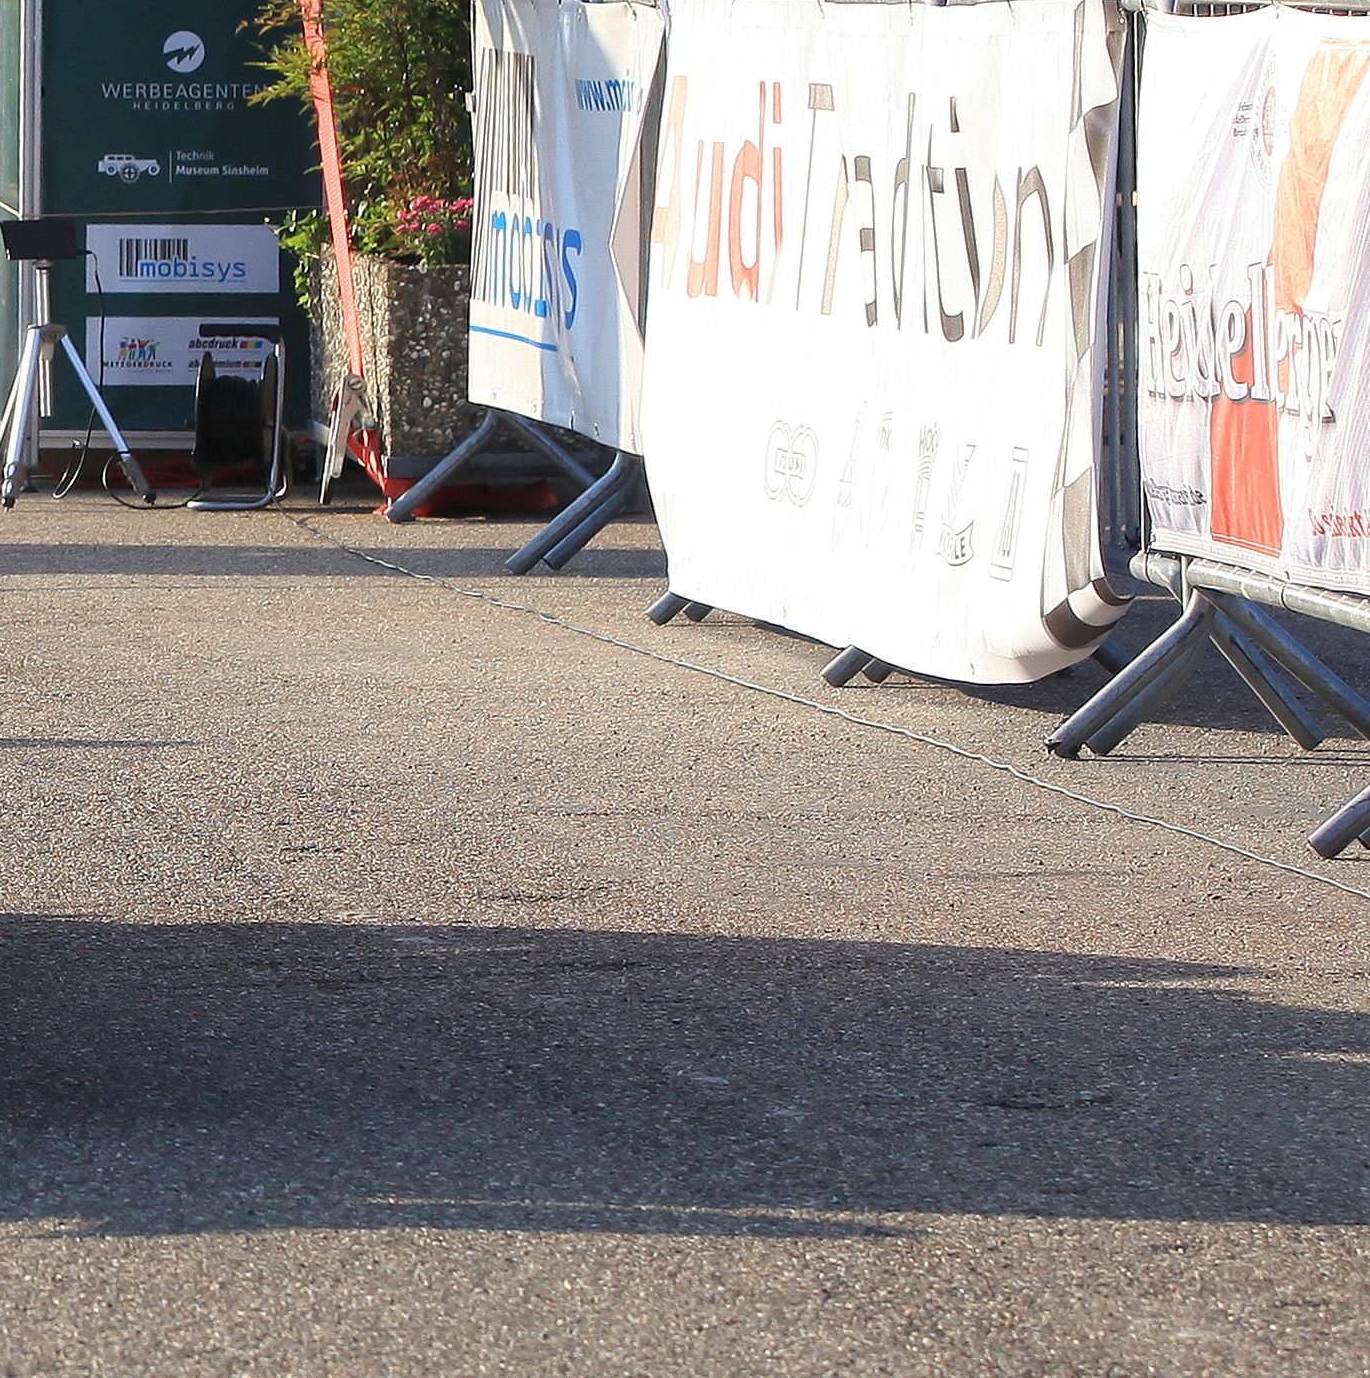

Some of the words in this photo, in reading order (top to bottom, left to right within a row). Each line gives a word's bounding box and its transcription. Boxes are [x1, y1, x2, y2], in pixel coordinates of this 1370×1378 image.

[132, 101, 236, 111] HEIDELBERG
[175, 150, 215, 161] Technik
[175, 165, 220, 176] Museum
[222, 164, 269, 176] Sinsheim
[139, 255, 247, 283] mobisys
